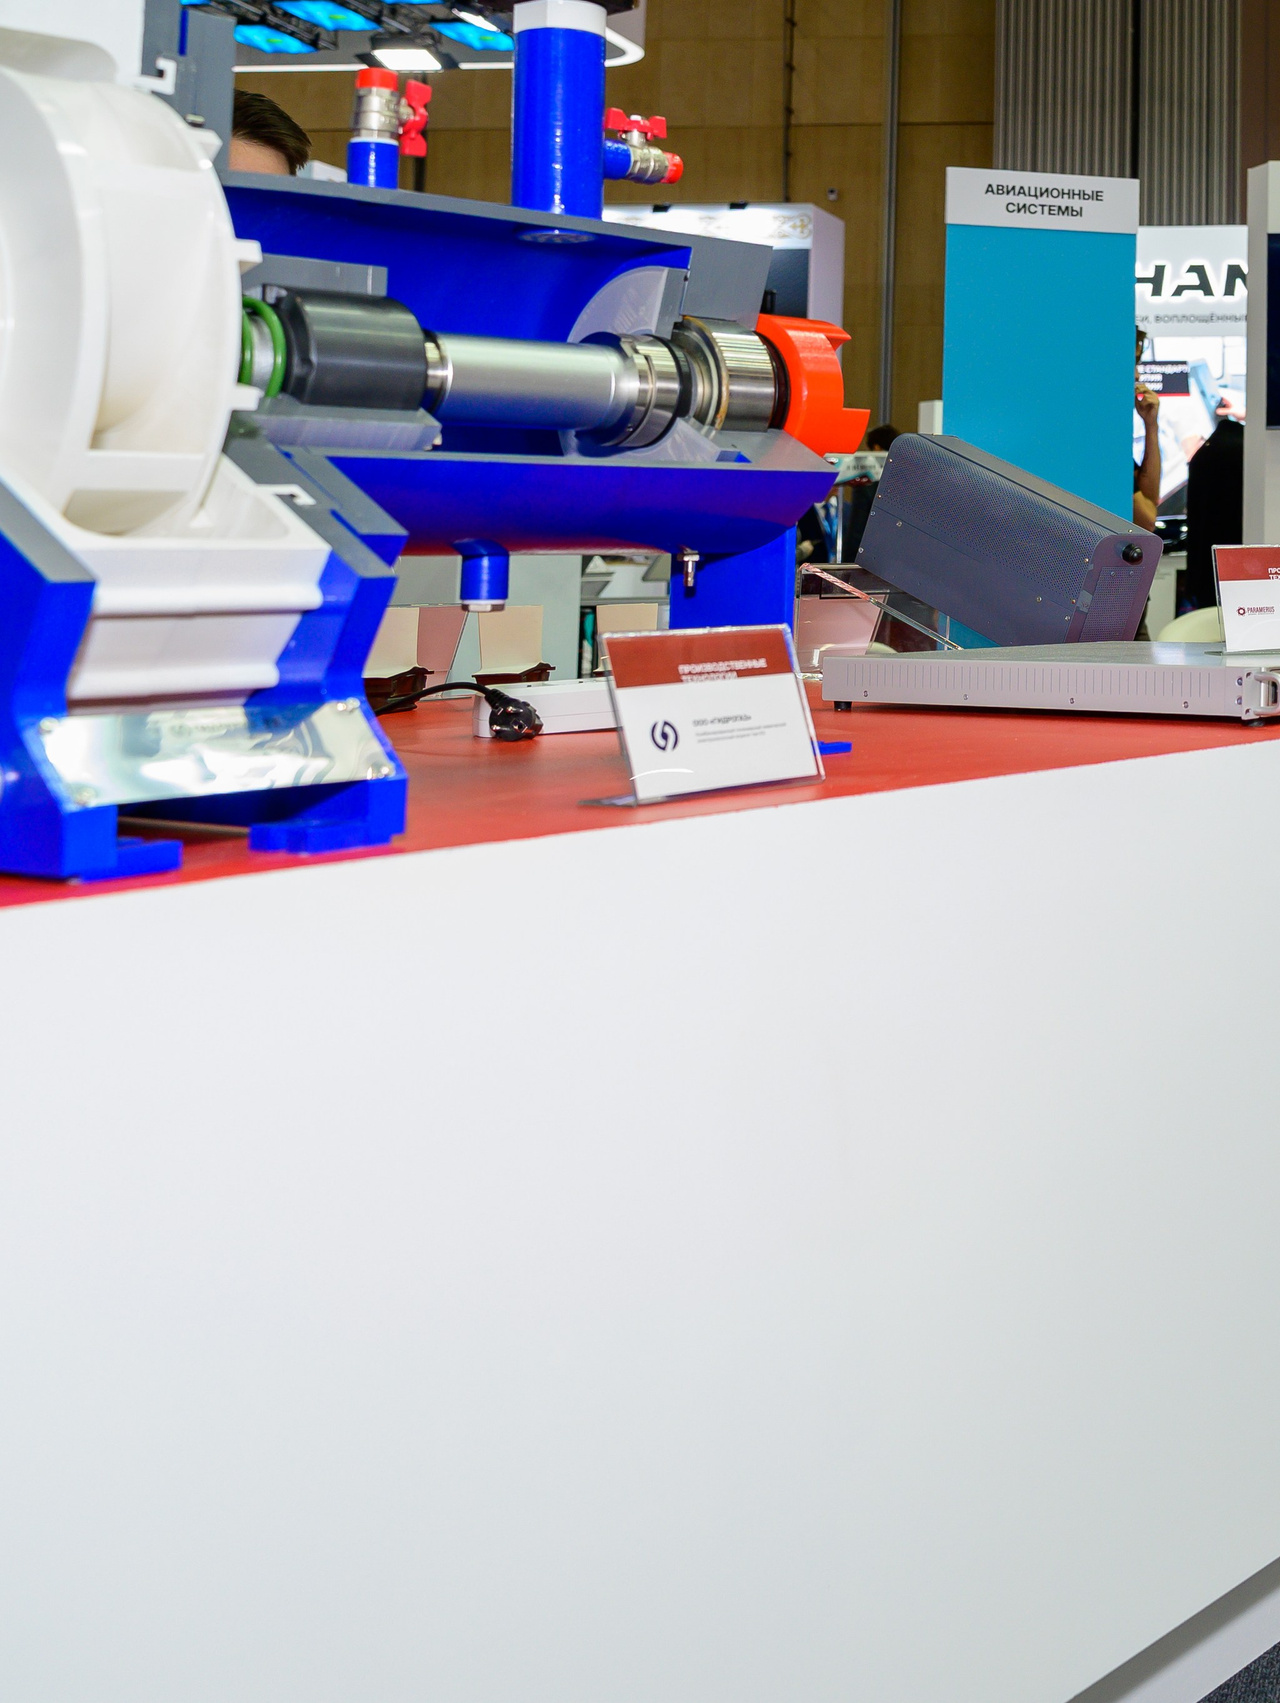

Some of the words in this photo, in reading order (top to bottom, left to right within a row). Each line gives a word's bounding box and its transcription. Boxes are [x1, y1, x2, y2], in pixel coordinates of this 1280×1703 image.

[985, 183, 1104, 201] АВИАЦИОННЫЕ
[1005, 202, 1083, 217] СИСТЕМЫ
[1154, 313, 1247, 325] ВОПЛОЩЁННЫ
